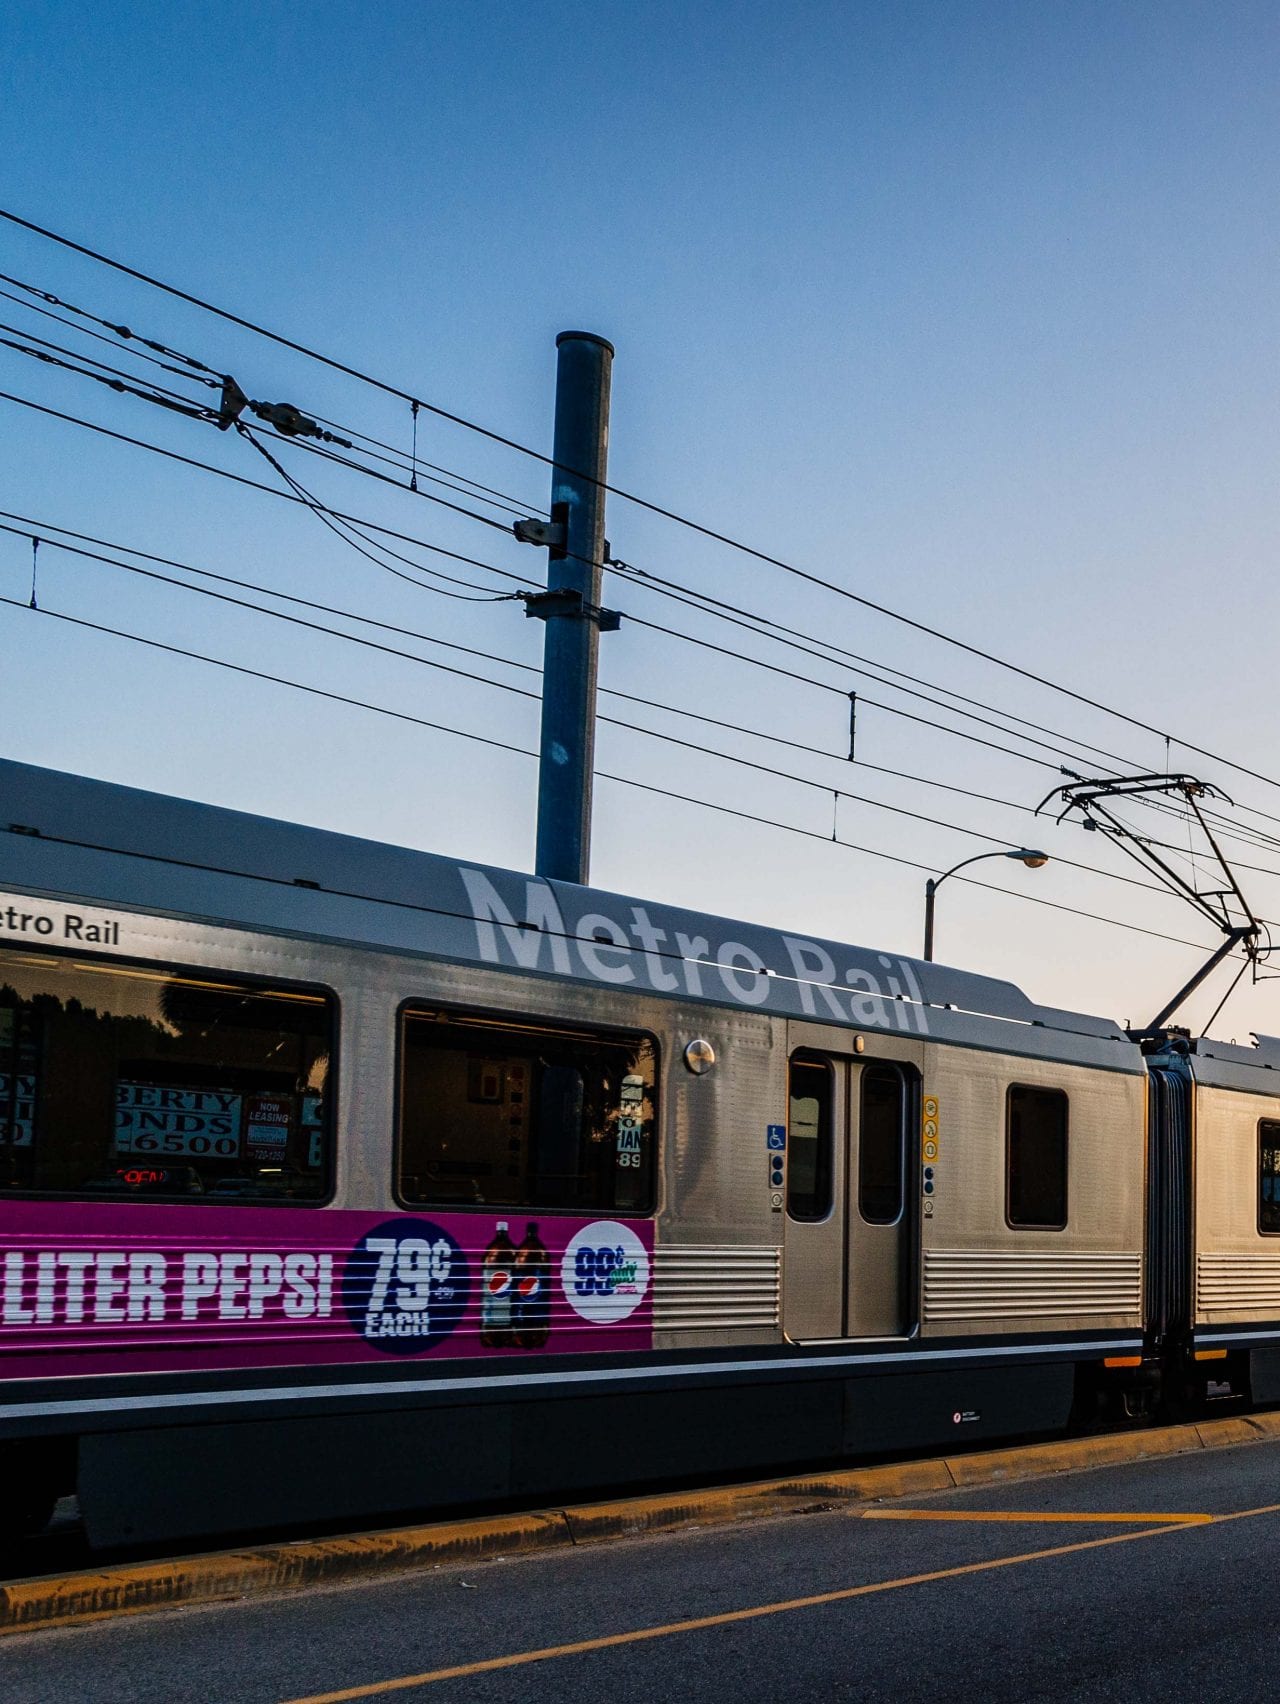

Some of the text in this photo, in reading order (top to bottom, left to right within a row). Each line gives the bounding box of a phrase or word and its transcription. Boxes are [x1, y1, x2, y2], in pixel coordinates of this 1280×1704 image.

[64, 914, 119, 945] Rail
[458, 866, 930, 1035] Metro Rail
[250, 1111, 289, 1124] LEASING
[260, 1102, 280, 1112] NOW
[1, 1252, 334, 1325] LITER PEPSI
[365, 1312, 431, 1338] EACH
